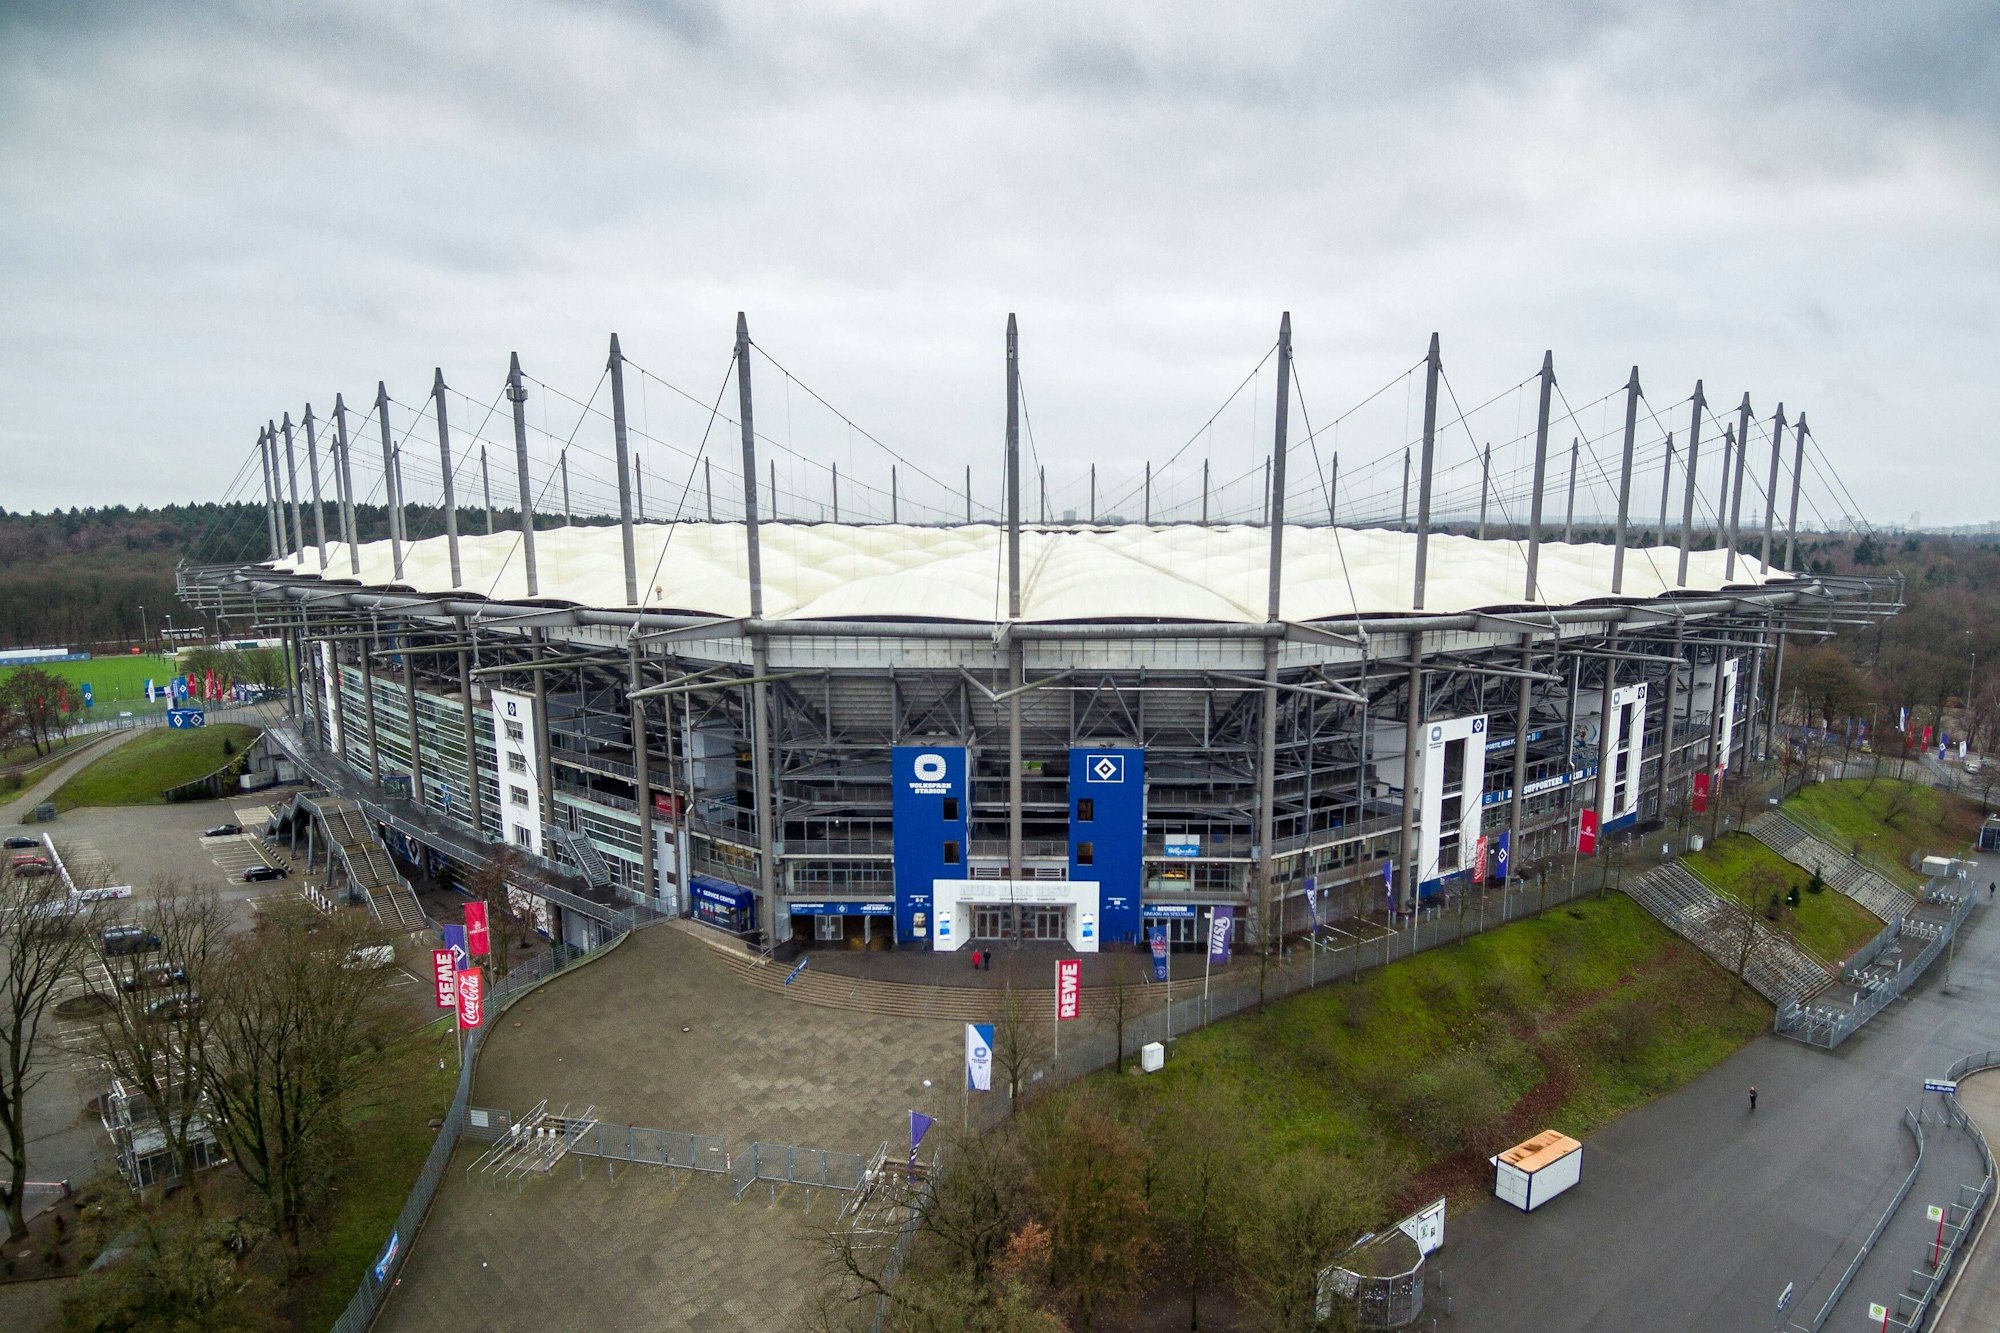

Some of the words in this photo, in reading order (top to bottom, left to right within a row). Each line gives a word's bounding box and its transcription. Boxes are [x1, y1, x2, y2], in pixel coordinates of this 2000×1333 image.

[1523, 775, 1563, 794] SUPPORTERS
[702, 889, 720, 901] SERVICE
[719, 894, 736, 906] CENTER
[1211, 917, 1228, 955] VILSA
[1060, 963, 1078, 1018] REWE
